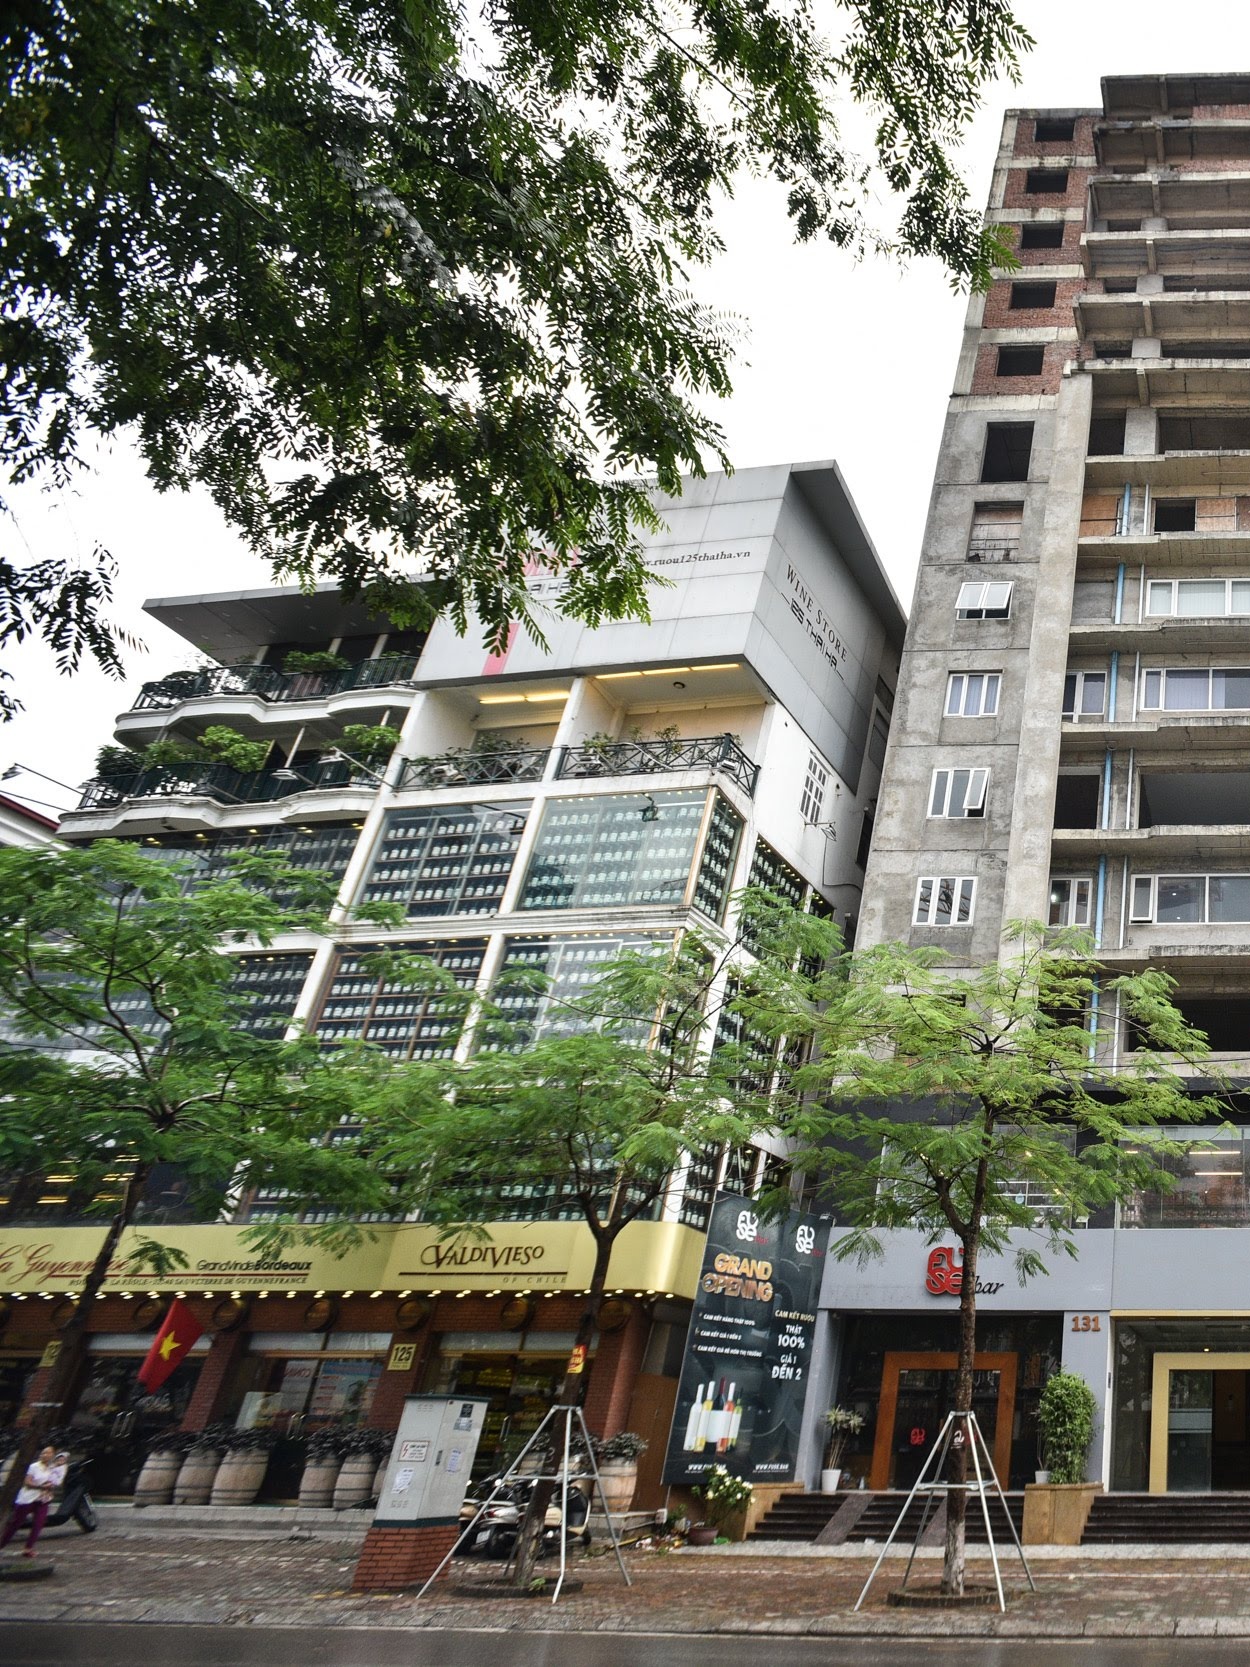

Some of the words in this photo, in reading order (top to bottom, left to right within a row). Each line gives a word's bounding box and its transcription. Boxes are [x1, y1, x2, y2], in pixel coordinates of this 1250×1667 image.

[787, 564, 813, 613] WINE
[816, 609, 847, 662] STORE
[714, 1252, 772, 1281] GRAND
[527, 1276, 567, 1284] CHILE
[703, 1272, 773, 1302] OPENING
[975, 1276, 1004, 1295] bar
[1072, 1316, 1101, 1332] 131
[778, 1334, 805, 1349] 100%
[393, 1346, 414, 1362] 125
[781, 1352, 793, 1363] GIÁ
[793, 1355, 797, 1364] 1
[771, 1363, 794, 1380] ĐẾN
[795, 1368, 802, 1381] 2
